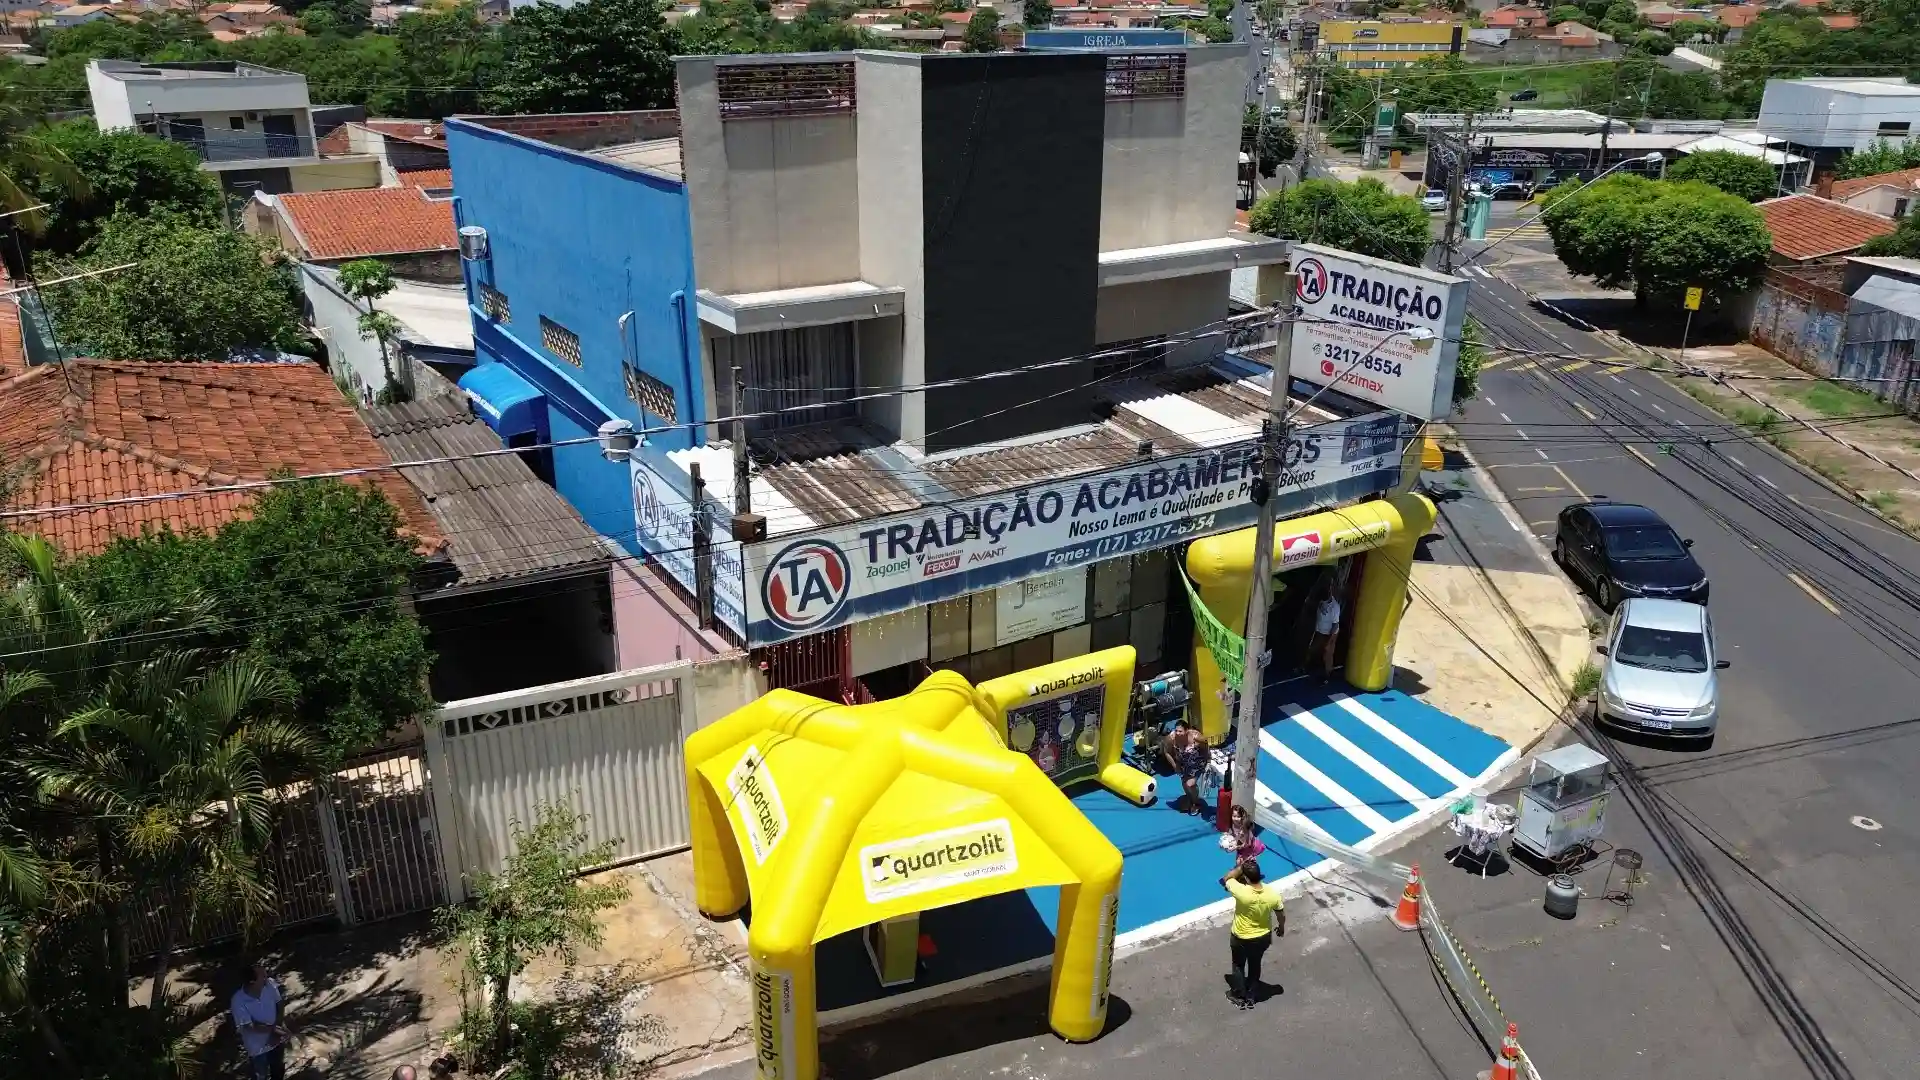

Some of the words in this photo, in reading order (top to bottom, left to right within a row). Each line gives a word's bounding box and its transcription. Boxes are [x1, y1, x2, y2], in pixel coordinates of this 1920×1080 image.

[1084, 35, 1126, 47] IGREJA
[1301, 267, 1320, 297] TA
[1330, 270, 1442, 321] TRADIÇÃO
[1349, 336, 1369, 349] Tintas
[1324, 343, 1402, 378] 3217-8554
[1334, 369, 1384, 394] cozimax
[1351, 460, 1373, 473] TIGRE
[860, 488, 1064, 564] TRADIÇÃO
[1071, 434, 1322, 517] ACABAMENOS
[1068, 519, 1109, 538] Nosso
[1112, 509, 1147, 528] Lema
[1150, 502, 1158, 519] é
[1161, 488, 1224, 516] Qualidade
[1227, 488, 1234, 501] e
[1279, 468, 1316, 489] Baixos
[1045, 547, 1091, 567] Fone:
[1095, 534, 1127, 558] (17)
[1343, 528, 1387, 548] quartzolit
[866, 558, 911, 579] Zagonel
[968, 545, 1008, 564] AVANT
[1283, 545, 1320, 564] brasilit
[780, 556, 834, 613] TA
[1041, 666, 1105, 695] quartzolit
[744, 775, 780, 847] quartzolit
[893, 832, 1005, 879] quartzolit
[754, 971, 779, 1061] quartzolit
